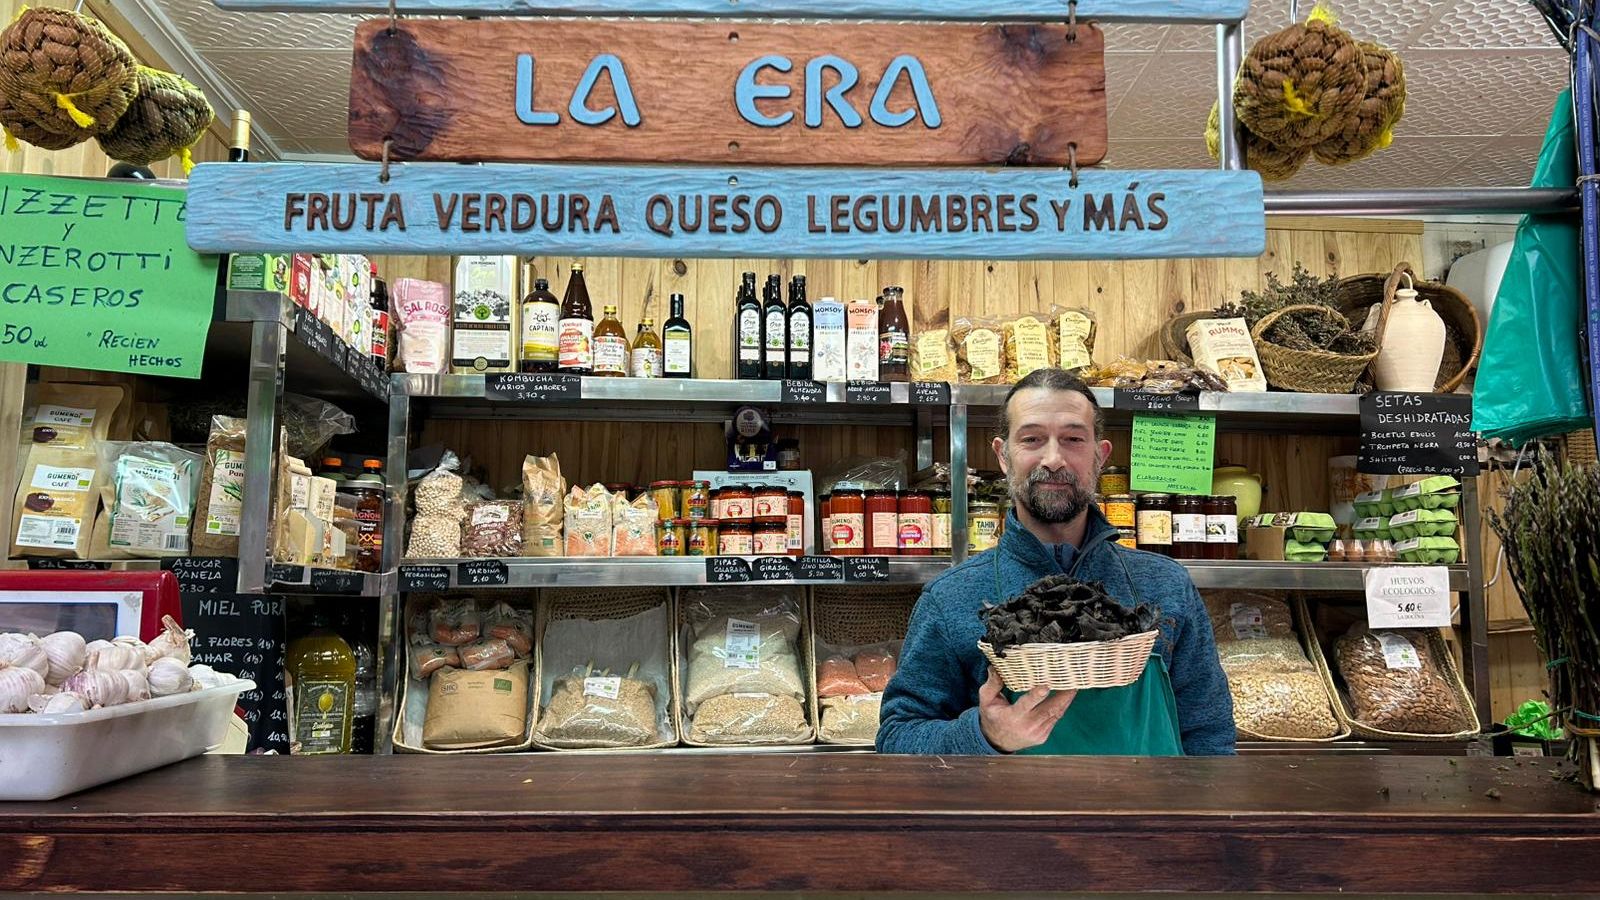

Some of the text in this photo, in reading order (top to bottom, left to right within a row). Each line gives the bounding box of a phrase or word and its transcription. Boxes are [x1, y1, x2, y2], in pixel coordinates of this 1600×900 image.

[515, 53, 942, 128] LA ERA
[284, 182, 1168, 237] FRUTA VERDURA QUESO LEGUMBRES Y MÁS
[3, 283, 144, 307] CASEROS
[403, 302, 423, 316] SAL
[424, 302, 450, 318] ROSA
[529, 325, 555, 333] CAPTAIN
[1208, 326, 1245, 336] RUMMO
[129, 355, 182, 368] HECHOS
[500, 375, 553, 383] KOMBUCHA
[1375, 394, 1423, 408] SETAS
[1377, 411, 1470, 424] DESHIDRATADAS
[225, 462, 245, 470] GUM
[38, 561, 68, 569] SAL
[172, 558, 222, 569] AZUCAR
[759, 564, 791, 572] GIRASOL
[1390, 577, 1425, 585] HUEVOS
[199, 600, 241, 616] MIEL
[1397, 602, 1422, 612] 5.60 €
[208, 636, 254, 647] FLORES
